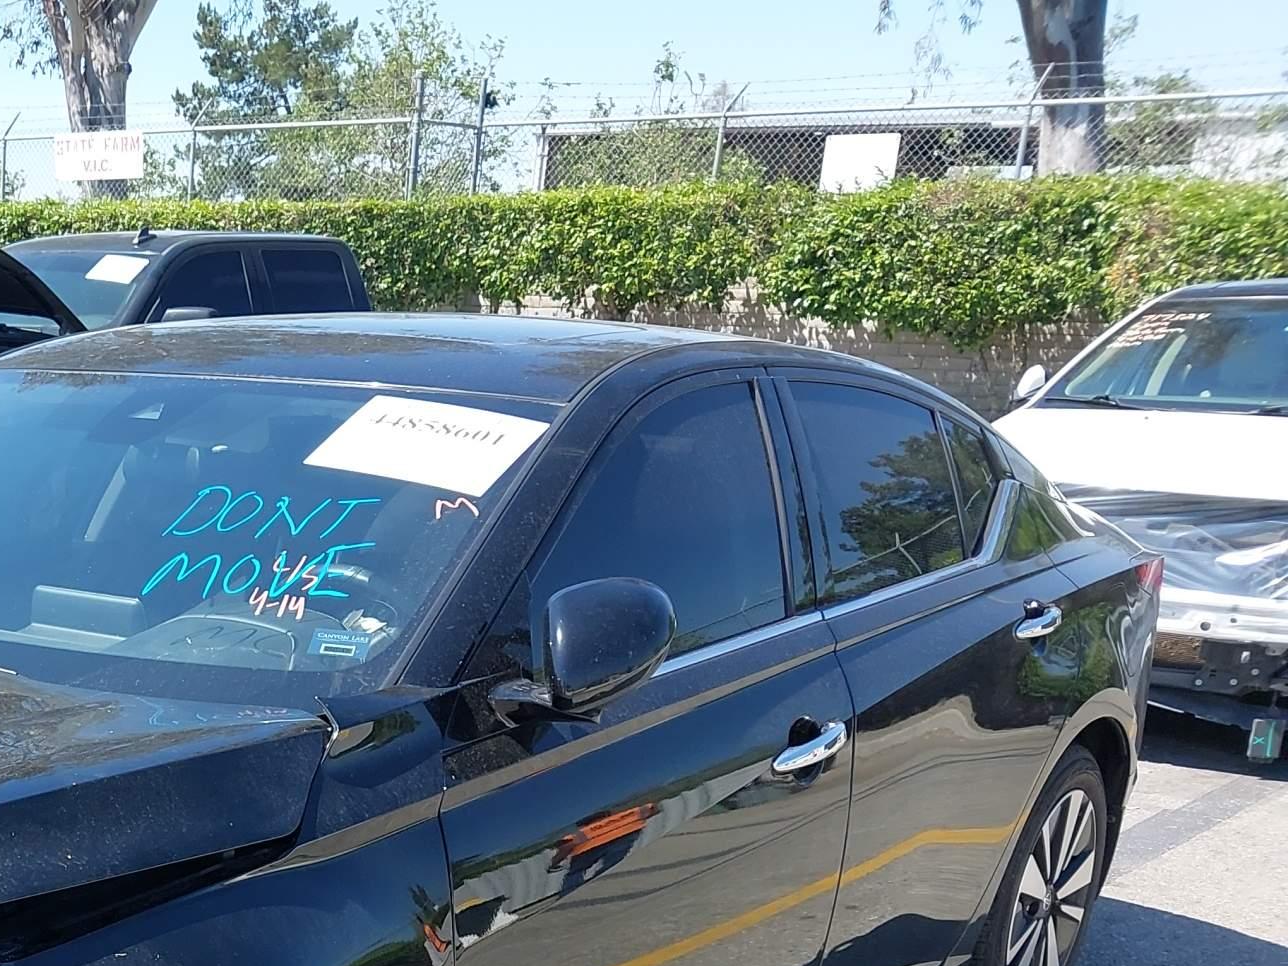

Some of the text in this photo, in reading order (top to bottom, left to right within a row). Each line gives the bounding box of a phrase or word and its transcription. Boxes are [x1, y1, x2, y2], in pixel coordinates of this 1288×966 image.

[104, 136, 140, 152] FARM
[162, 485, 381, 539] DONT
[142, 542, 376, 599] MOVE
[249, 586, 305, 619] 4-14
